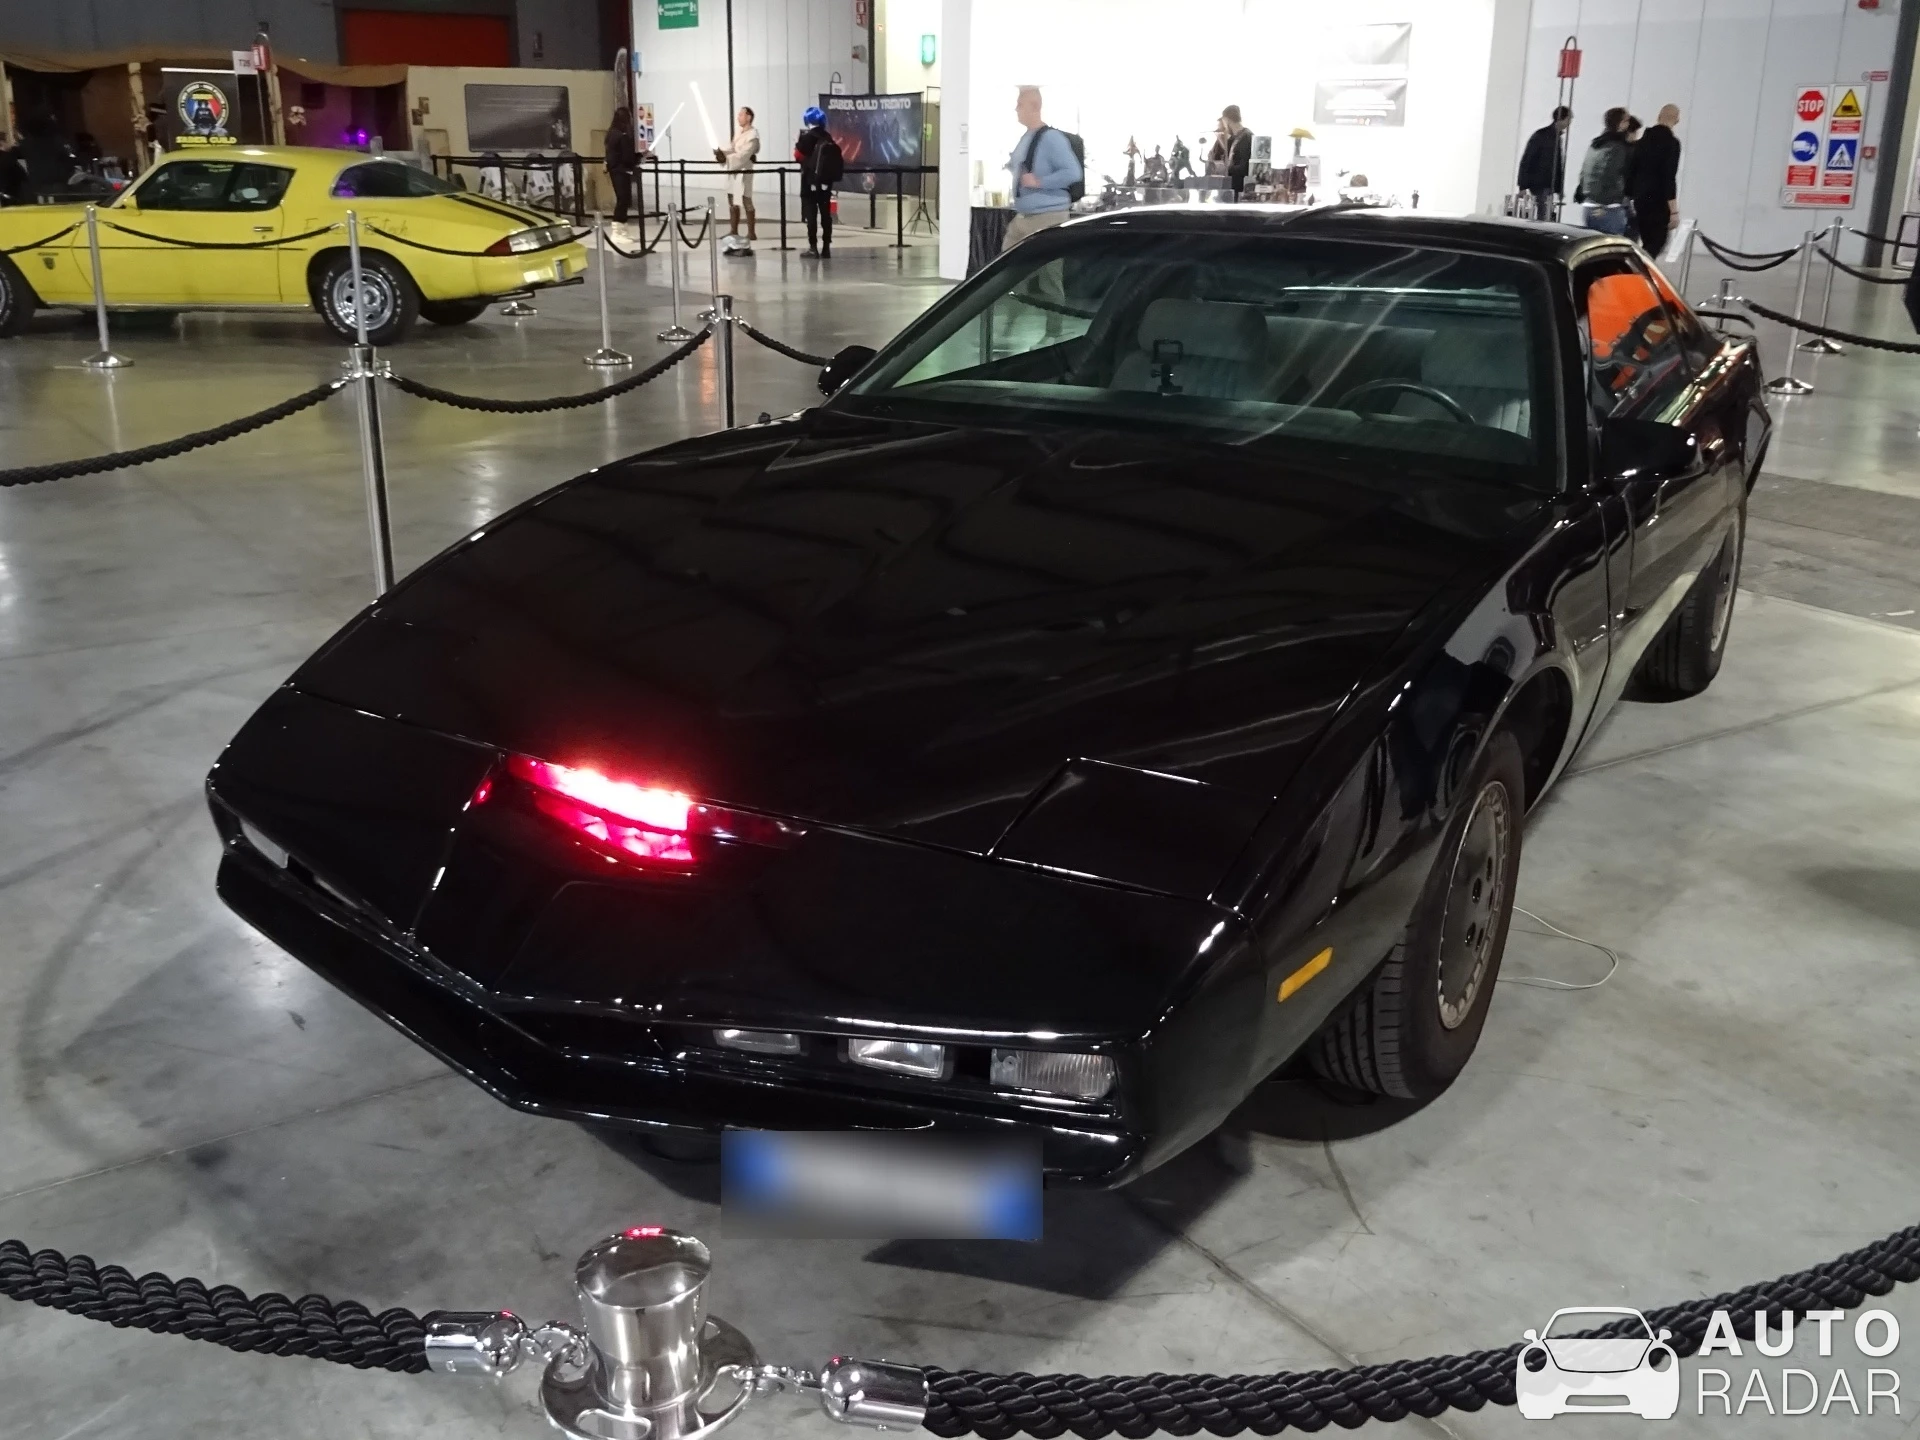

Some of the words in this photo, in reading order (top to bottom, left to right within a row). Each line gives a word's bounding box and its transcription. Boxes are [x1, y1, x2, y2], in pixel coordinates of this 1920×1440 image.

[828, 99, 855, 110] SABER
[856, 99, 878, 110] GUILD
[880, 98, 911, 109] TRENTO
[1798, 100, 1824, 112] STOP
[209, 136, 237, 144] GUILD
